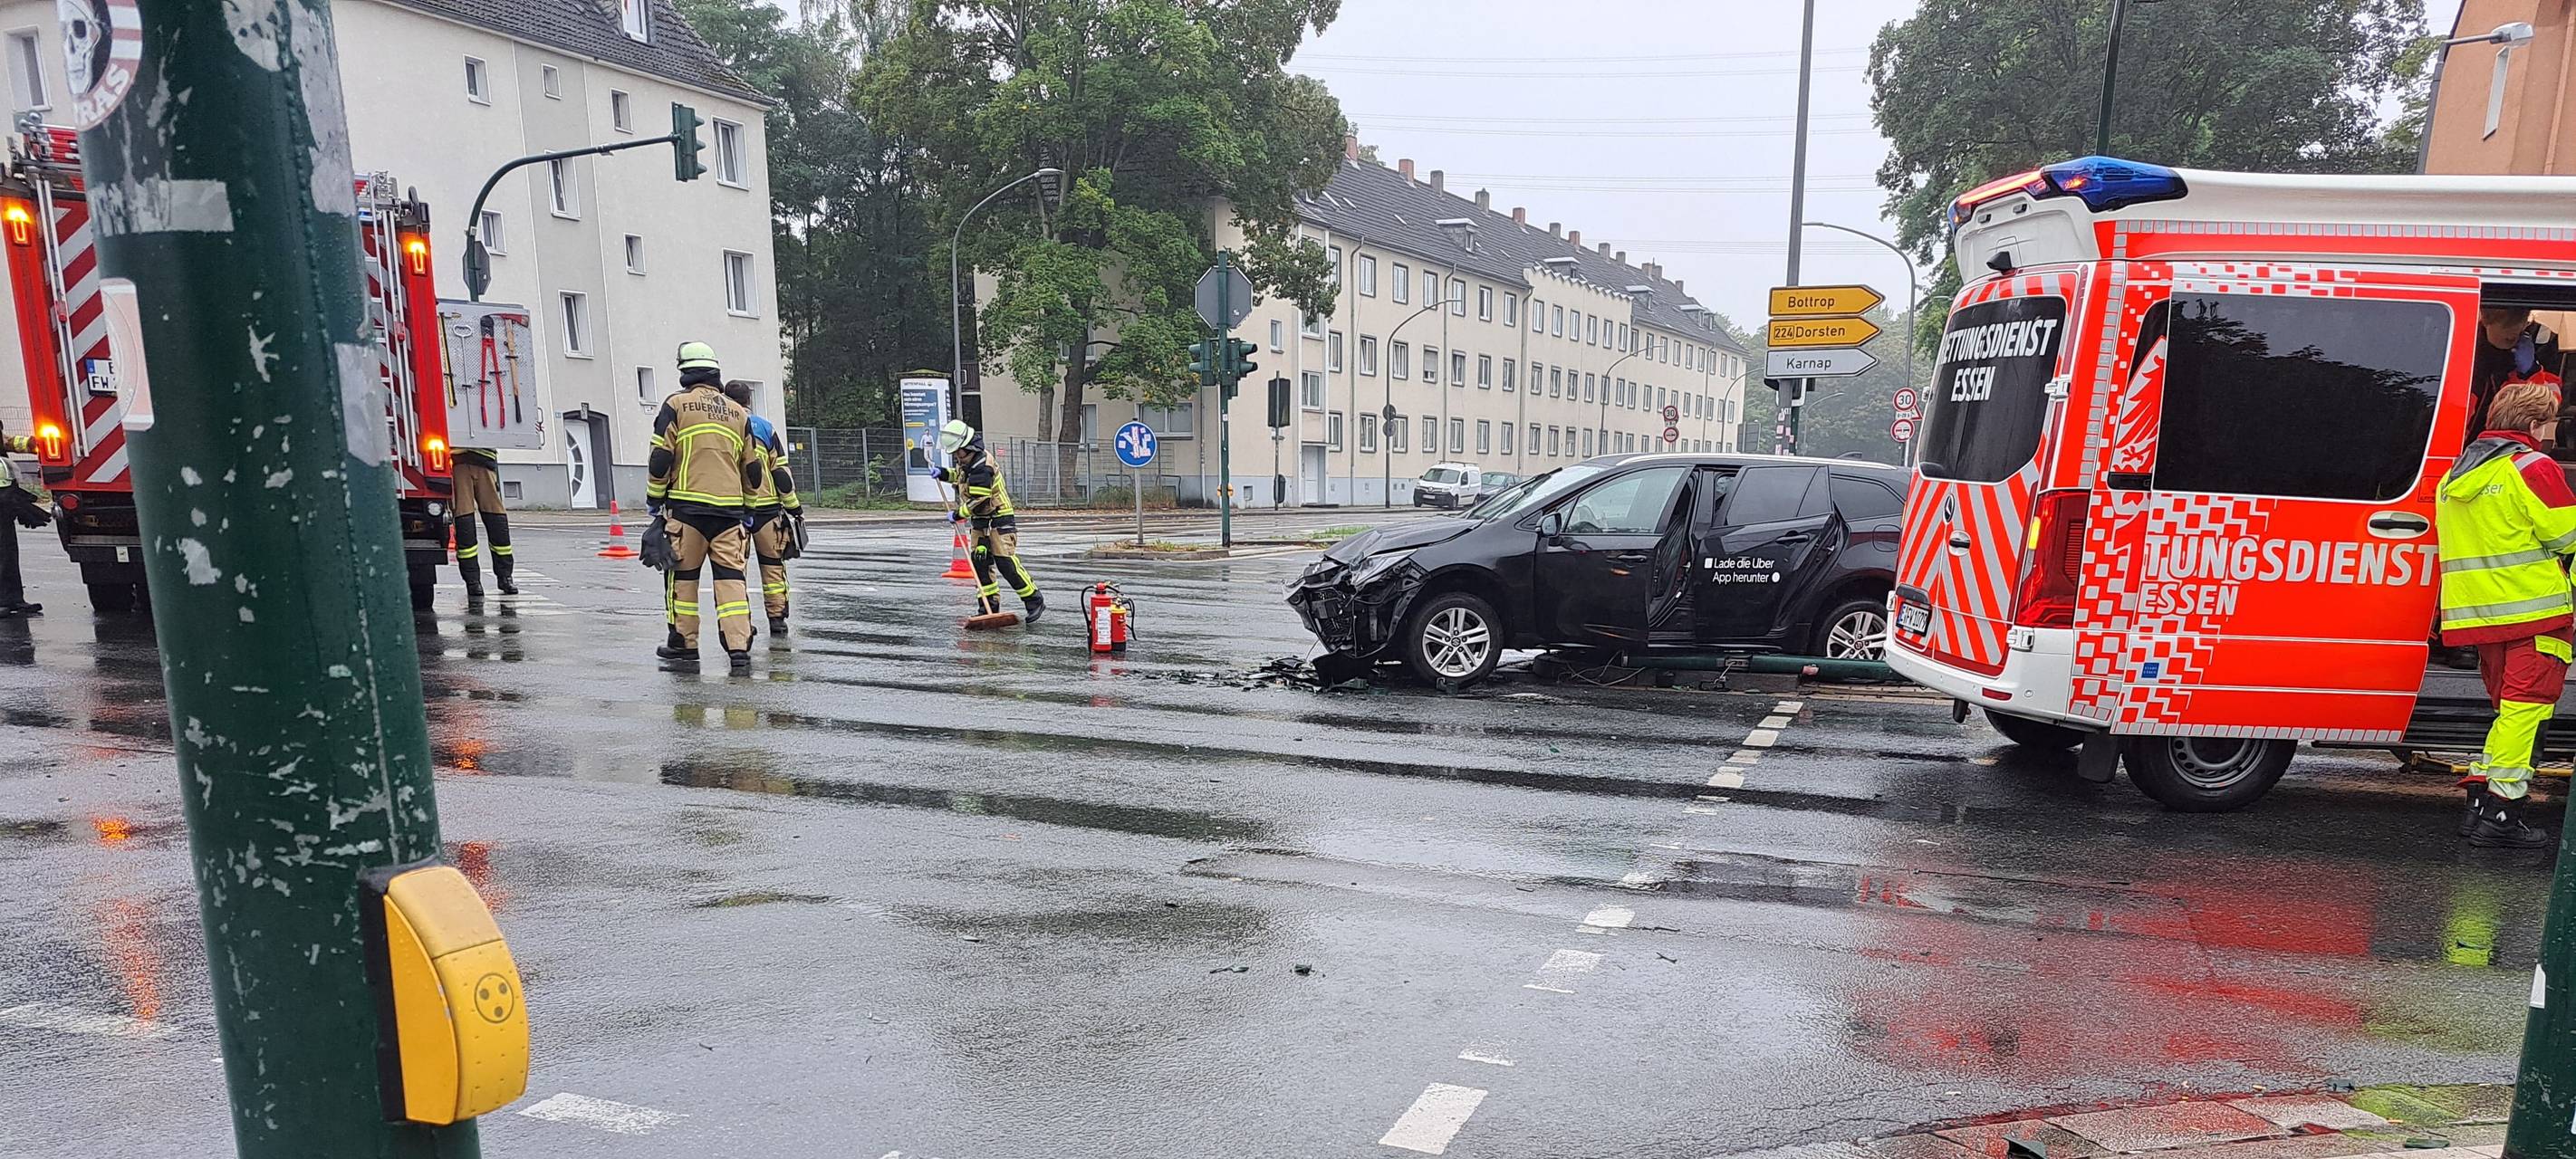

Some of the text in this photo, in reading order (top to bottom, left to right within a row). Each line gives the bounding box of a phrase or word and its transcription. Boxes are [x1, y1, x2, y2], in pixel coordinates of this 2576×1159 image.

[74, 63, 130, 128] RAS
[1788, 296, 1835, 310] Bottrop
[1774, 326, 1846, 338] 224 Dorsten
[1939, 319, 2058, 364] RETTUNGSDIENST
[1786, 358, 1831, 371] Karnap
[91, 376, 109, 388] FW
[1951, 366, 1996, 401] ESSEN
[1898, 394, 1912, 405] 30
[682, 401, 740, 420] FEUERWEHR
[1666, 409, 1675, 417] 30
[707, 413, 729, 422] ESSEN
[2479, 484, 2504, 495] ser
[1714, 557, 1775, 569] Lade die Uber
[2145, 535, 2438, 586] TUNGSDIENST
[1712, 571, 1770, 585] App herunter
[2138, 582, 2240, 616] ESSEN
